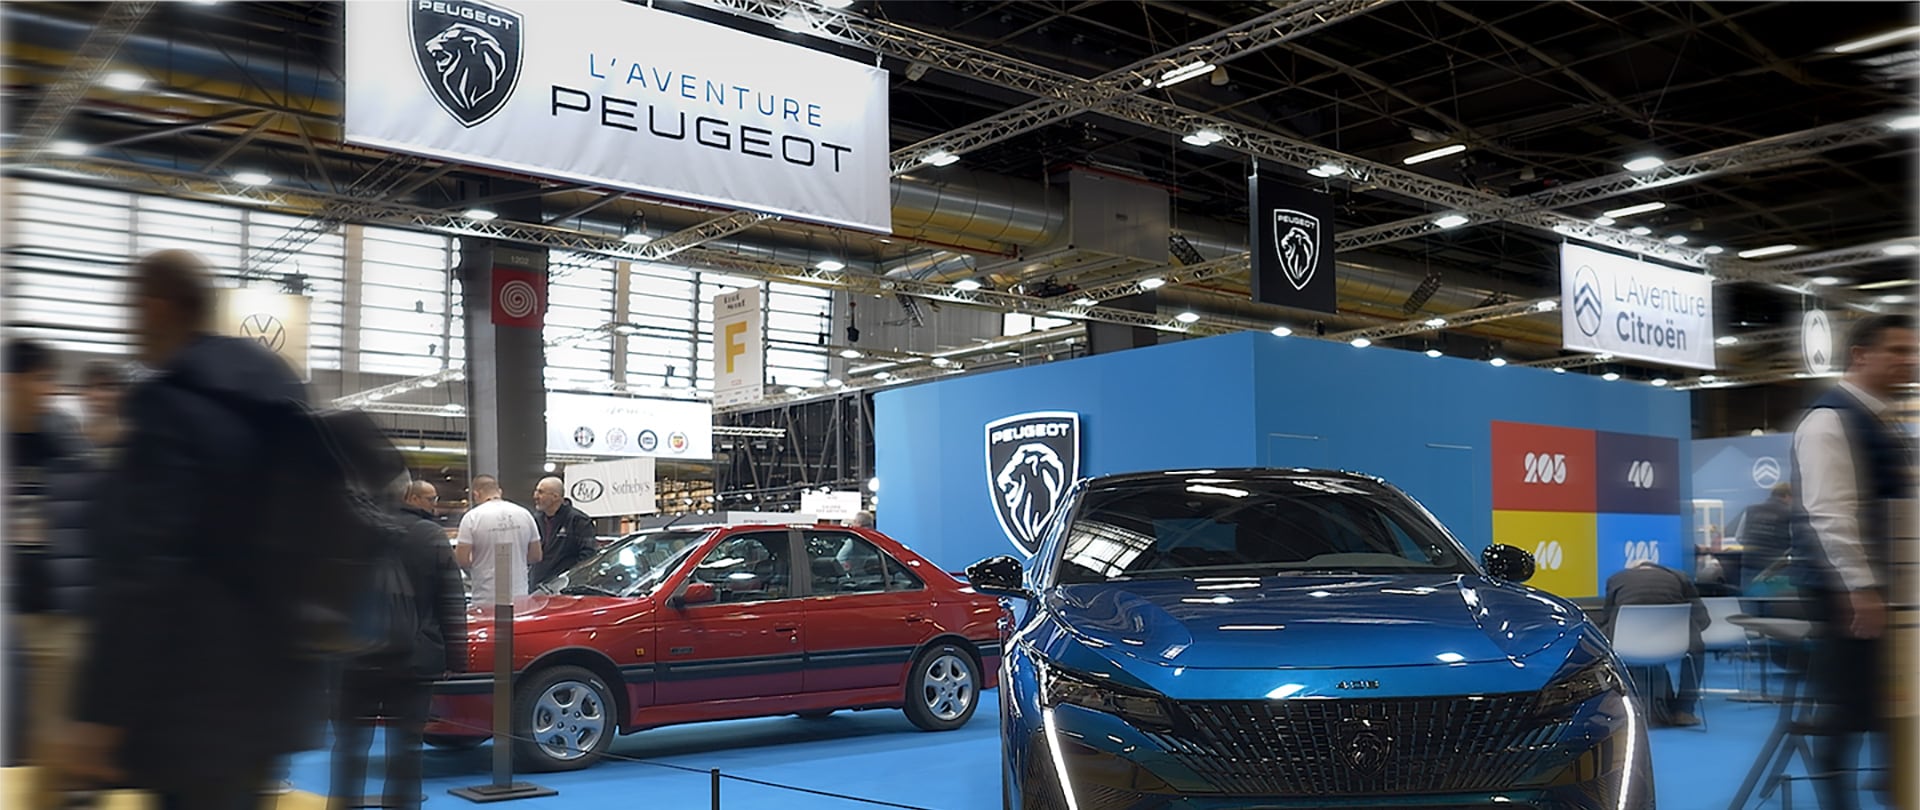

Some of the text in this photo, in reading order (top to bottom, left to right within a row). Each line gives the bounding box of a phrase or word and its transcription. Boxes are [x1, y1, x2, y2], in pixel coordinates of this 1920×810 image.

[418, 1, 513, 30] PEUGEOT
[590, 53, 822, 127] L'AVENTURE
[551, 85, 852, 172] PEUGEOT
[1277, 214, 1315, 229] PEUGEOT
[1616, 311, 1687, 350] Citroën
[725, 320, 747, 374] F
[991, 423, 1069, 444] PEUGEOT
[1524, 452, 1566, 484] 205
[1628, 461, 1654, 488] 40
[1535, 540, 1563, 570] 40
